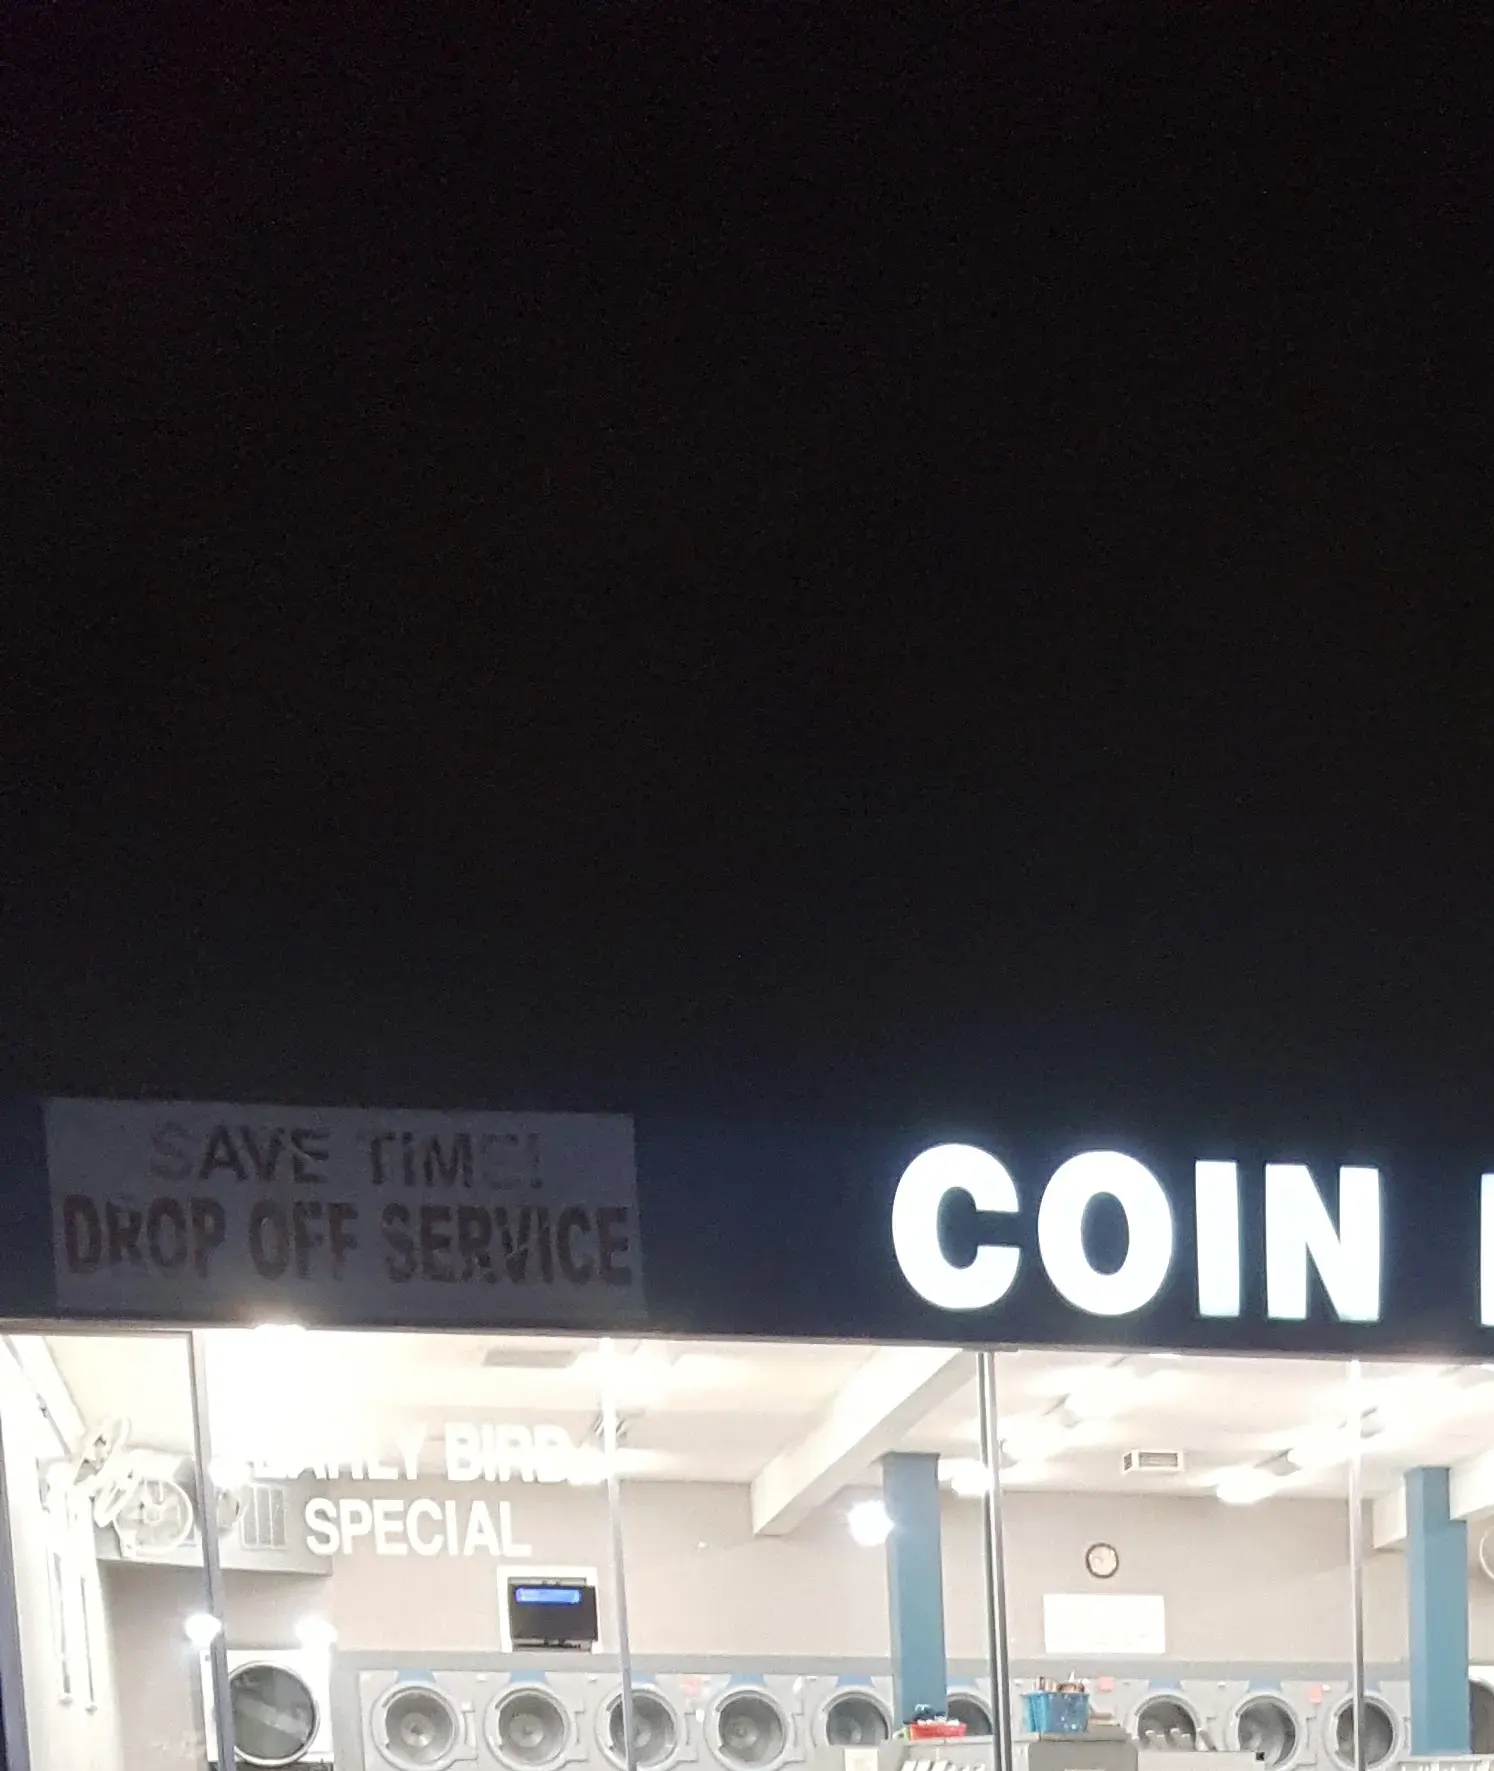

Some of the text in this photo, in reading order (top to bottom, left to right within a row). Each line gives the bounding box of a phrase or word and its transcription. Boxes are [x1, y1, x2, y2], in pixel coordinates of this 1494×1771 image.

[149, 1120, 331, 1184] SAVE
[62, 1193, 633, 1286] DROP OFF SERVICE
[891, 1142, 1380, 1323] COIN
[445, 1421, 573, 1483] BIRD
[304, 1497, 533, 1557] SPECIAL
